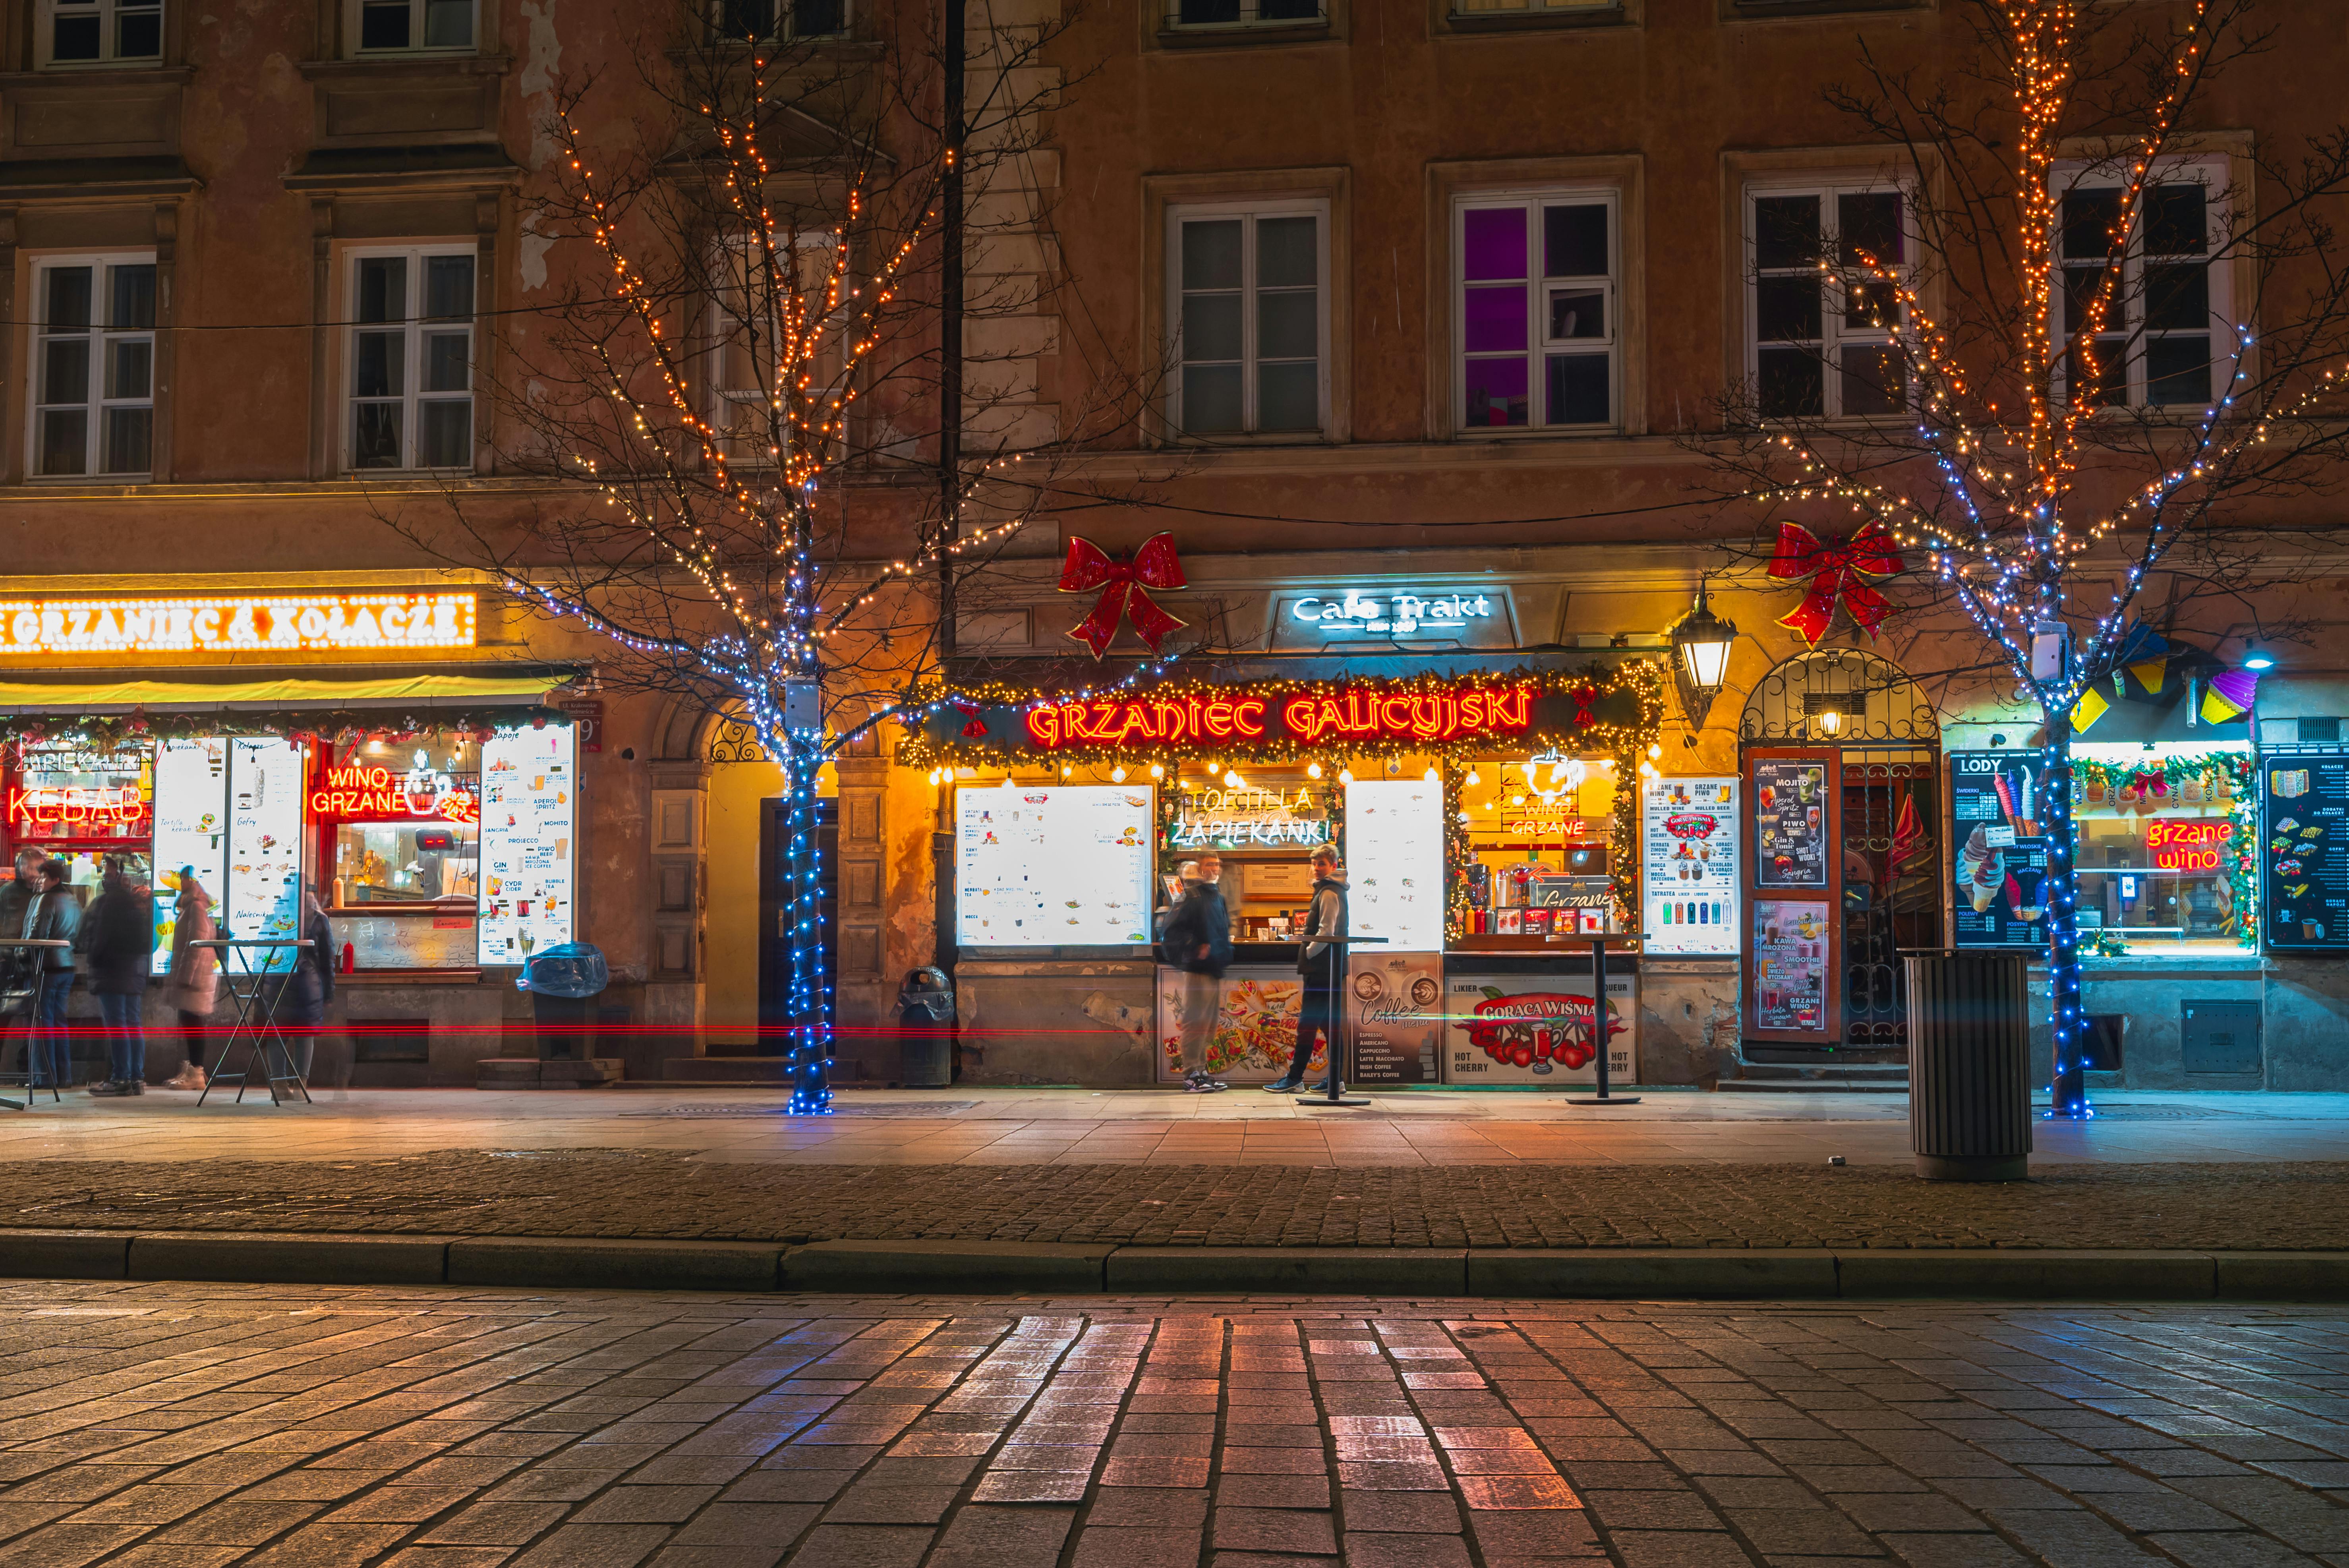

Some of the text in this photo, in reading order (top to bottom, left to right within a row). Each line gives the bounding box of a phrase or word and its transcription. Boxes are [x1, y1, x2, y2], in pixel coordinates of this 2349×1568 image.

[1293, 594, 1490, 621] Cafe Trakt
[12, 600, 458, 644] GRZANIEC & KOŁACZE
[1029, 697, 1264, 746] GRZANIEC
[580, 719, 593, 742] 9
[1961, 759, 2002, 772] LODY
[328, 768, 388, 788] WINO
[10, 786, 143, 823] KEBAB
[312, 792, 406, 812] GRZANE
[1187, 787, 1313, 812] TORTILLA
[1771, 795, 1794, 807] Aperol
[1525, 802, 1572, 816] WINO
[1777, 803, 1800, 814] Spritz
[237, 817, 256, 827] Gofry
[1511, 821, 1584, 835] GRZANE
[1172, 820, 1330, 844] ZAPIEKANKI
[2148, 824, 2231, 846] grzane
[2159, 848, 2218, 869] wino
[1782, 868, 1812, 880] Sangria
[236, 909, 269, 919] Naleśniki
[1784, 915, 1822, 927] Lemoniada
[1361, 998, 1422, 1026] Coffee
[1482, 1000, 1595, 1021] GORĄCA WIŚNIA
[1761, 1006, 1786, 1015] Herbata
[1402, 1020, 1429, 1029] menu
[1455, 1052, 1471, 1061] HOT
[1611, 1052, 1628, 1061] HOT
[1455, 1063, 1488, 1072] CHERRY
